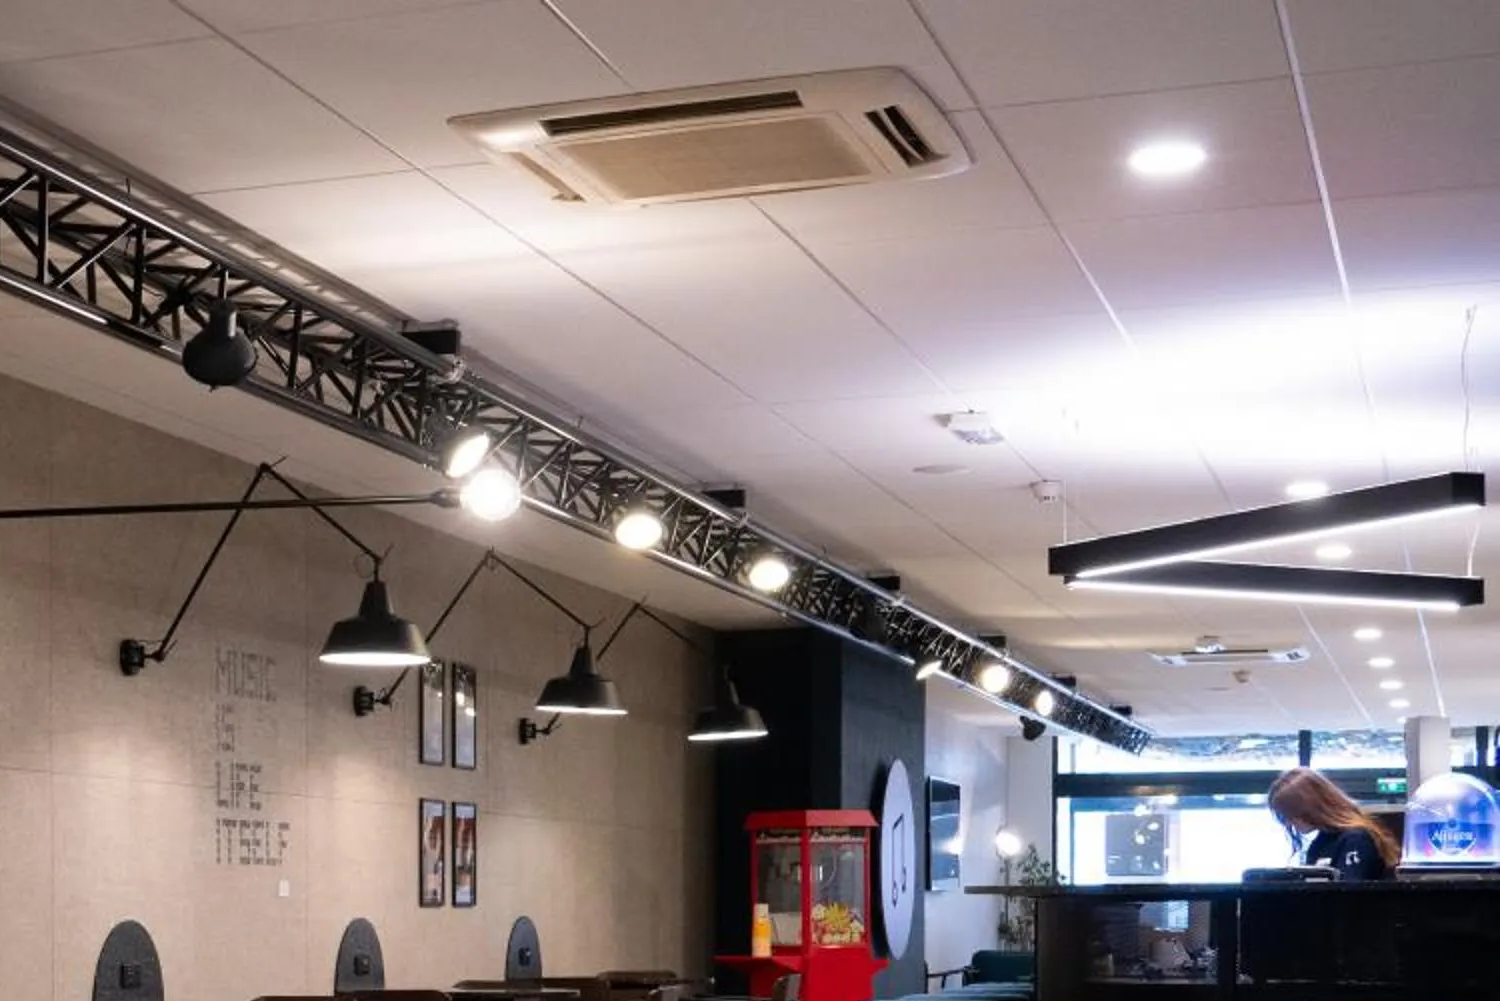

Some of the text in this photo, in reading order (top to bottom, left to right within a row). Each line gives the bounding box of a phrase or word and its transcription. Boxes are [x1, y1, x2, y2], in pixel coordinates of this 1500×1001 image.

[215, 648, 276, 702] MUSIC
[215, 761, 262, 811] LIFE
[215, 817, 290, 866] ITSELF
